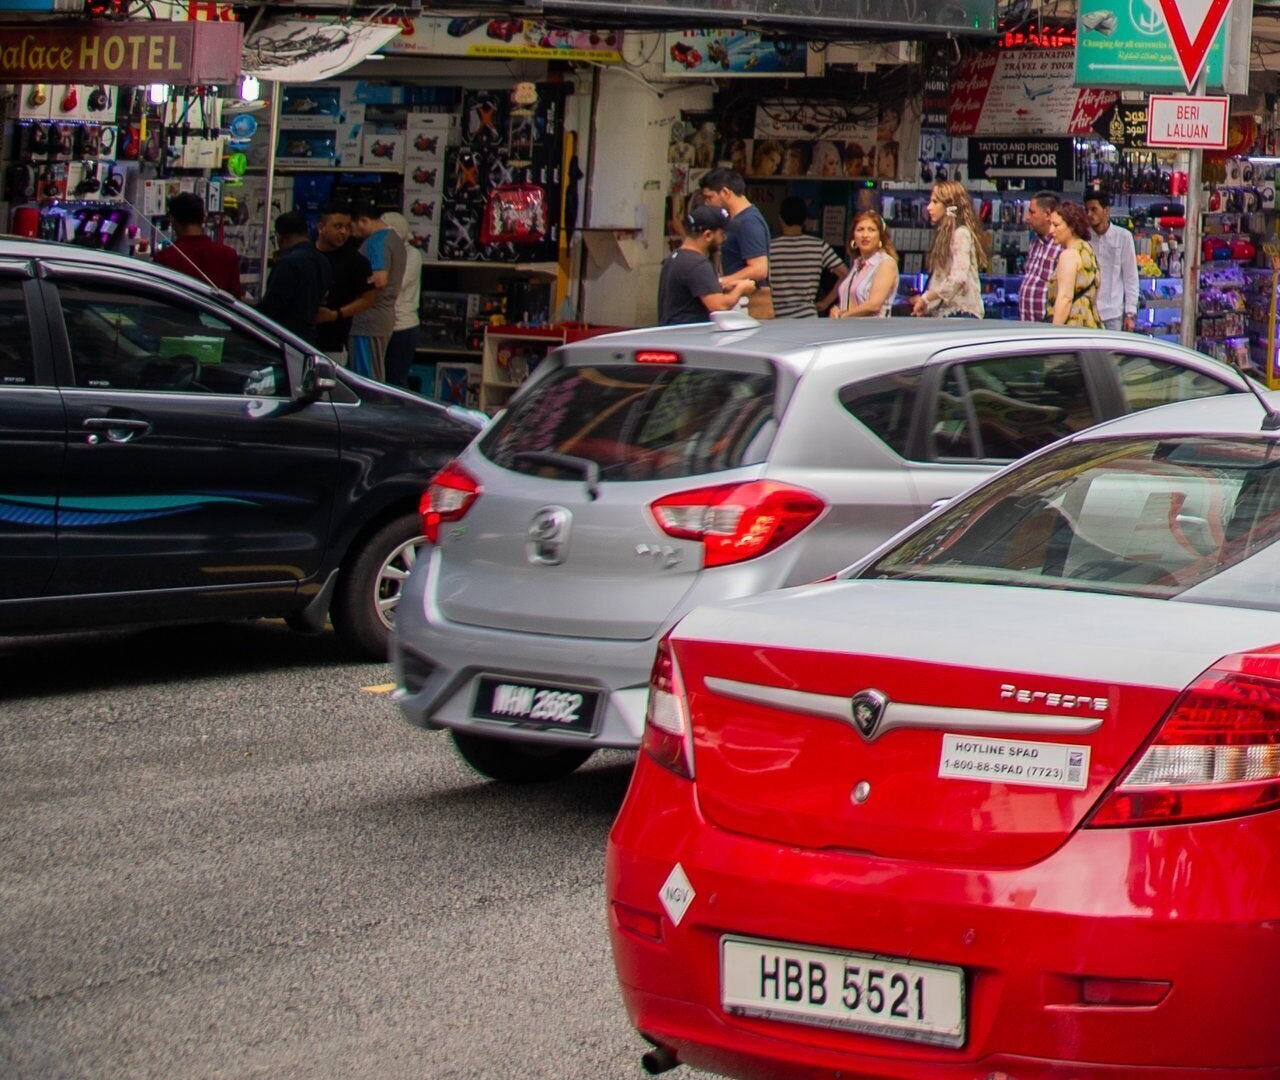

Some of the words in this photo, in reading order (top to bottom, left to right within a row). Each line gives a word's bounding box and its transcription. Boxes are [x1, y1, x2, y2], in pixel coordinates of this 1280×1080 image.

[0, 34, 74, 75] alace
[79, 35, 183, 71] HOTEL
[1004, 62, 1037, 71] TRAVEL
[1177, 106, 1200, 120] BERI
[1167, 123, 1208, 139] LALUAN
[979, 142, 1008, 151] TATTOO
[1009, 142, 1025, 151] AND
[1026, 143, 1059, 152] PIRCING
[984, 154, 1000, 165] AT
[1017, 154, 1057, 165] FLOOR
[955, 742, 1005, 756] HOTLINE
[1009, 746, 1039, 758] SPAD
[944, 759, 1023, 774] 1-800-88-SPAD
[1027, 765, 1064, 780] (7723)
[665, 887, 690, 903] NGV
[760, 954, 827, 1006] HBB
[842, 965, 925, 1020] 5521
